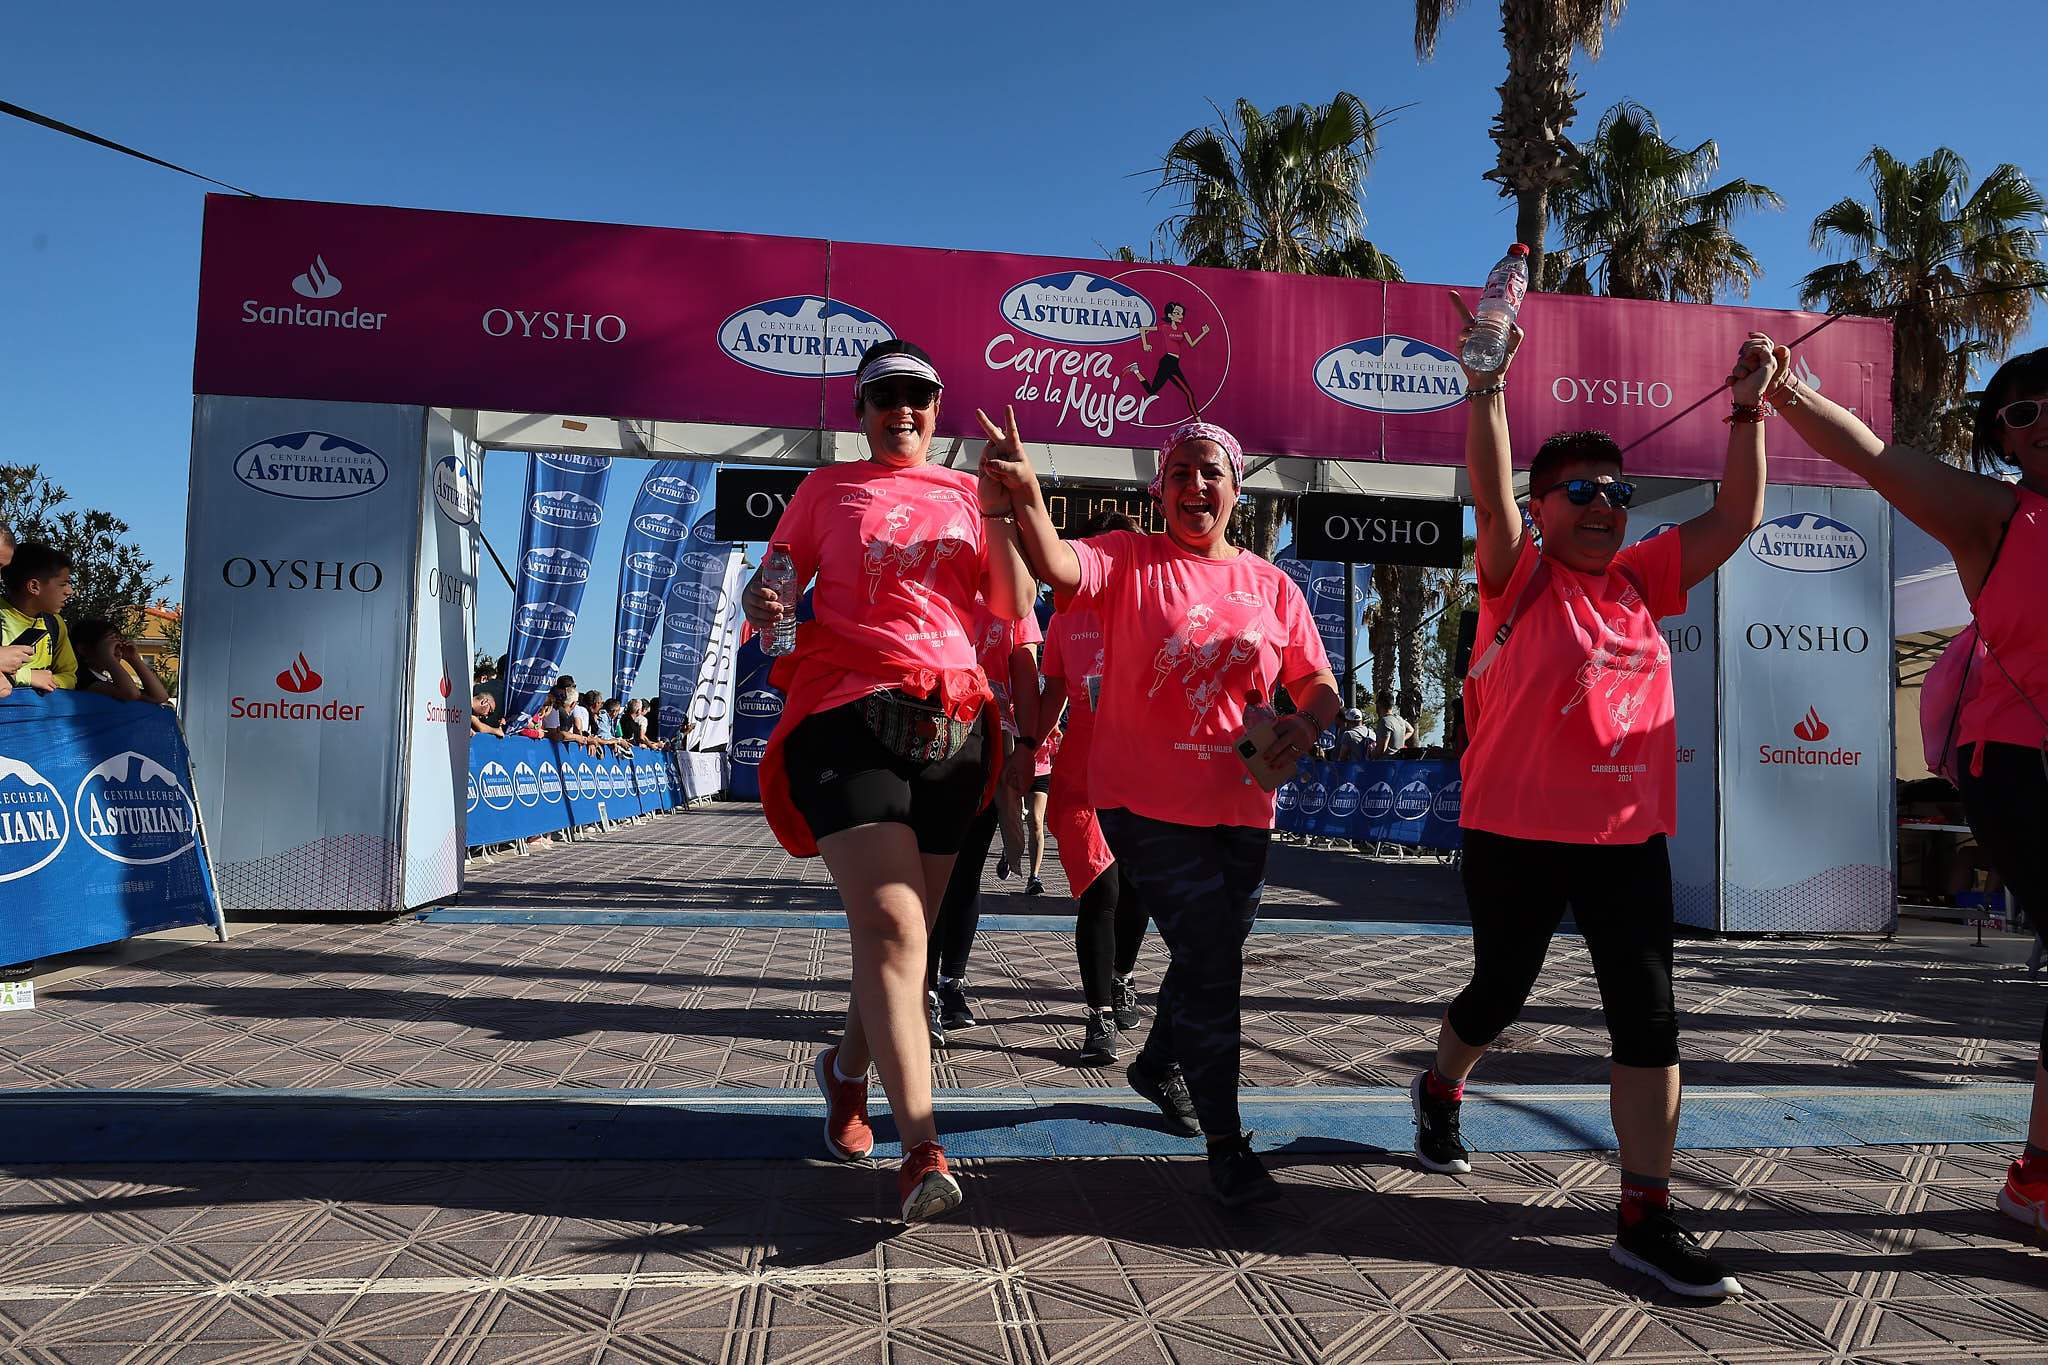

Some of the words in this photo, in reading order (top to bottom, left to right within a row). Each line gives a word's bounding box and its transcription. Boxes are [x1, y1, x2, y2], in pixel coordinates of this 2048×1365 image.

[1012, 293, 1143, 329] ASTURIANA
[1036, 293, 1085, 304] CENTRAL
[1090, 297, 1140, 308] LECHERA
[241, 300, 387, 330] Santander
[482, 308, 627, 343] OYSHO
[760, 320, 817, 332] CENTRAL
[731, 321, 878, 357] ASTURIAN
[984, 333, 1112, 378] Carrera
[1350, 359, 1401, 370] CENTRAL
[1405, 362, 1458, 373] LECHERA
[1325, 359, 1462, 396] ASTURIANA
[1552, 376, 1673, 408] OYSHO
[1015, 374, 1039, 401] de
[1044, 375, 1062, 403] la
[1056, 376, 1160, 438] Mujer
[244, 454, 377, 485] ASTURIANA
[270, 453, 317, 463] CENTRAL
[323, 456, 373, 465] LECHERA
[841, 487, 887, 505] OYSHO
[532, 498, 600, 523] ASTURIANA
[1324, 515, 1440, 546] OYSHO
[1774, 532, 1813, 541] CENTRAL
[1815, 533, 1854, 542] LECHERA
[1757, 533, 1858, 559] ASTURIANA
[222, 557, 383, 592] OYSHO
[429, 568, 472, 610] OYSHO
[1071, 631, 1100, 641] OYSHO
[1746, 622, 1869, 654] OYSHO
[231, 696, 365, 721] Santander
[426, 702, 463, 724] Santander
[738, 700, 781, 712] ASTURIANA
[1174, 742, 1199, 751] CARRERA
[1759, 745, 1862, 767] Santander
[1591, 764, 1620, 773] CARRERA
[1620, 764, 1629, 773] DE
[1617, 774, 1632, 782] 2024
[0, 791, 49, 804] ECHERA
[103, 789, 143, 801] CENTRAL
